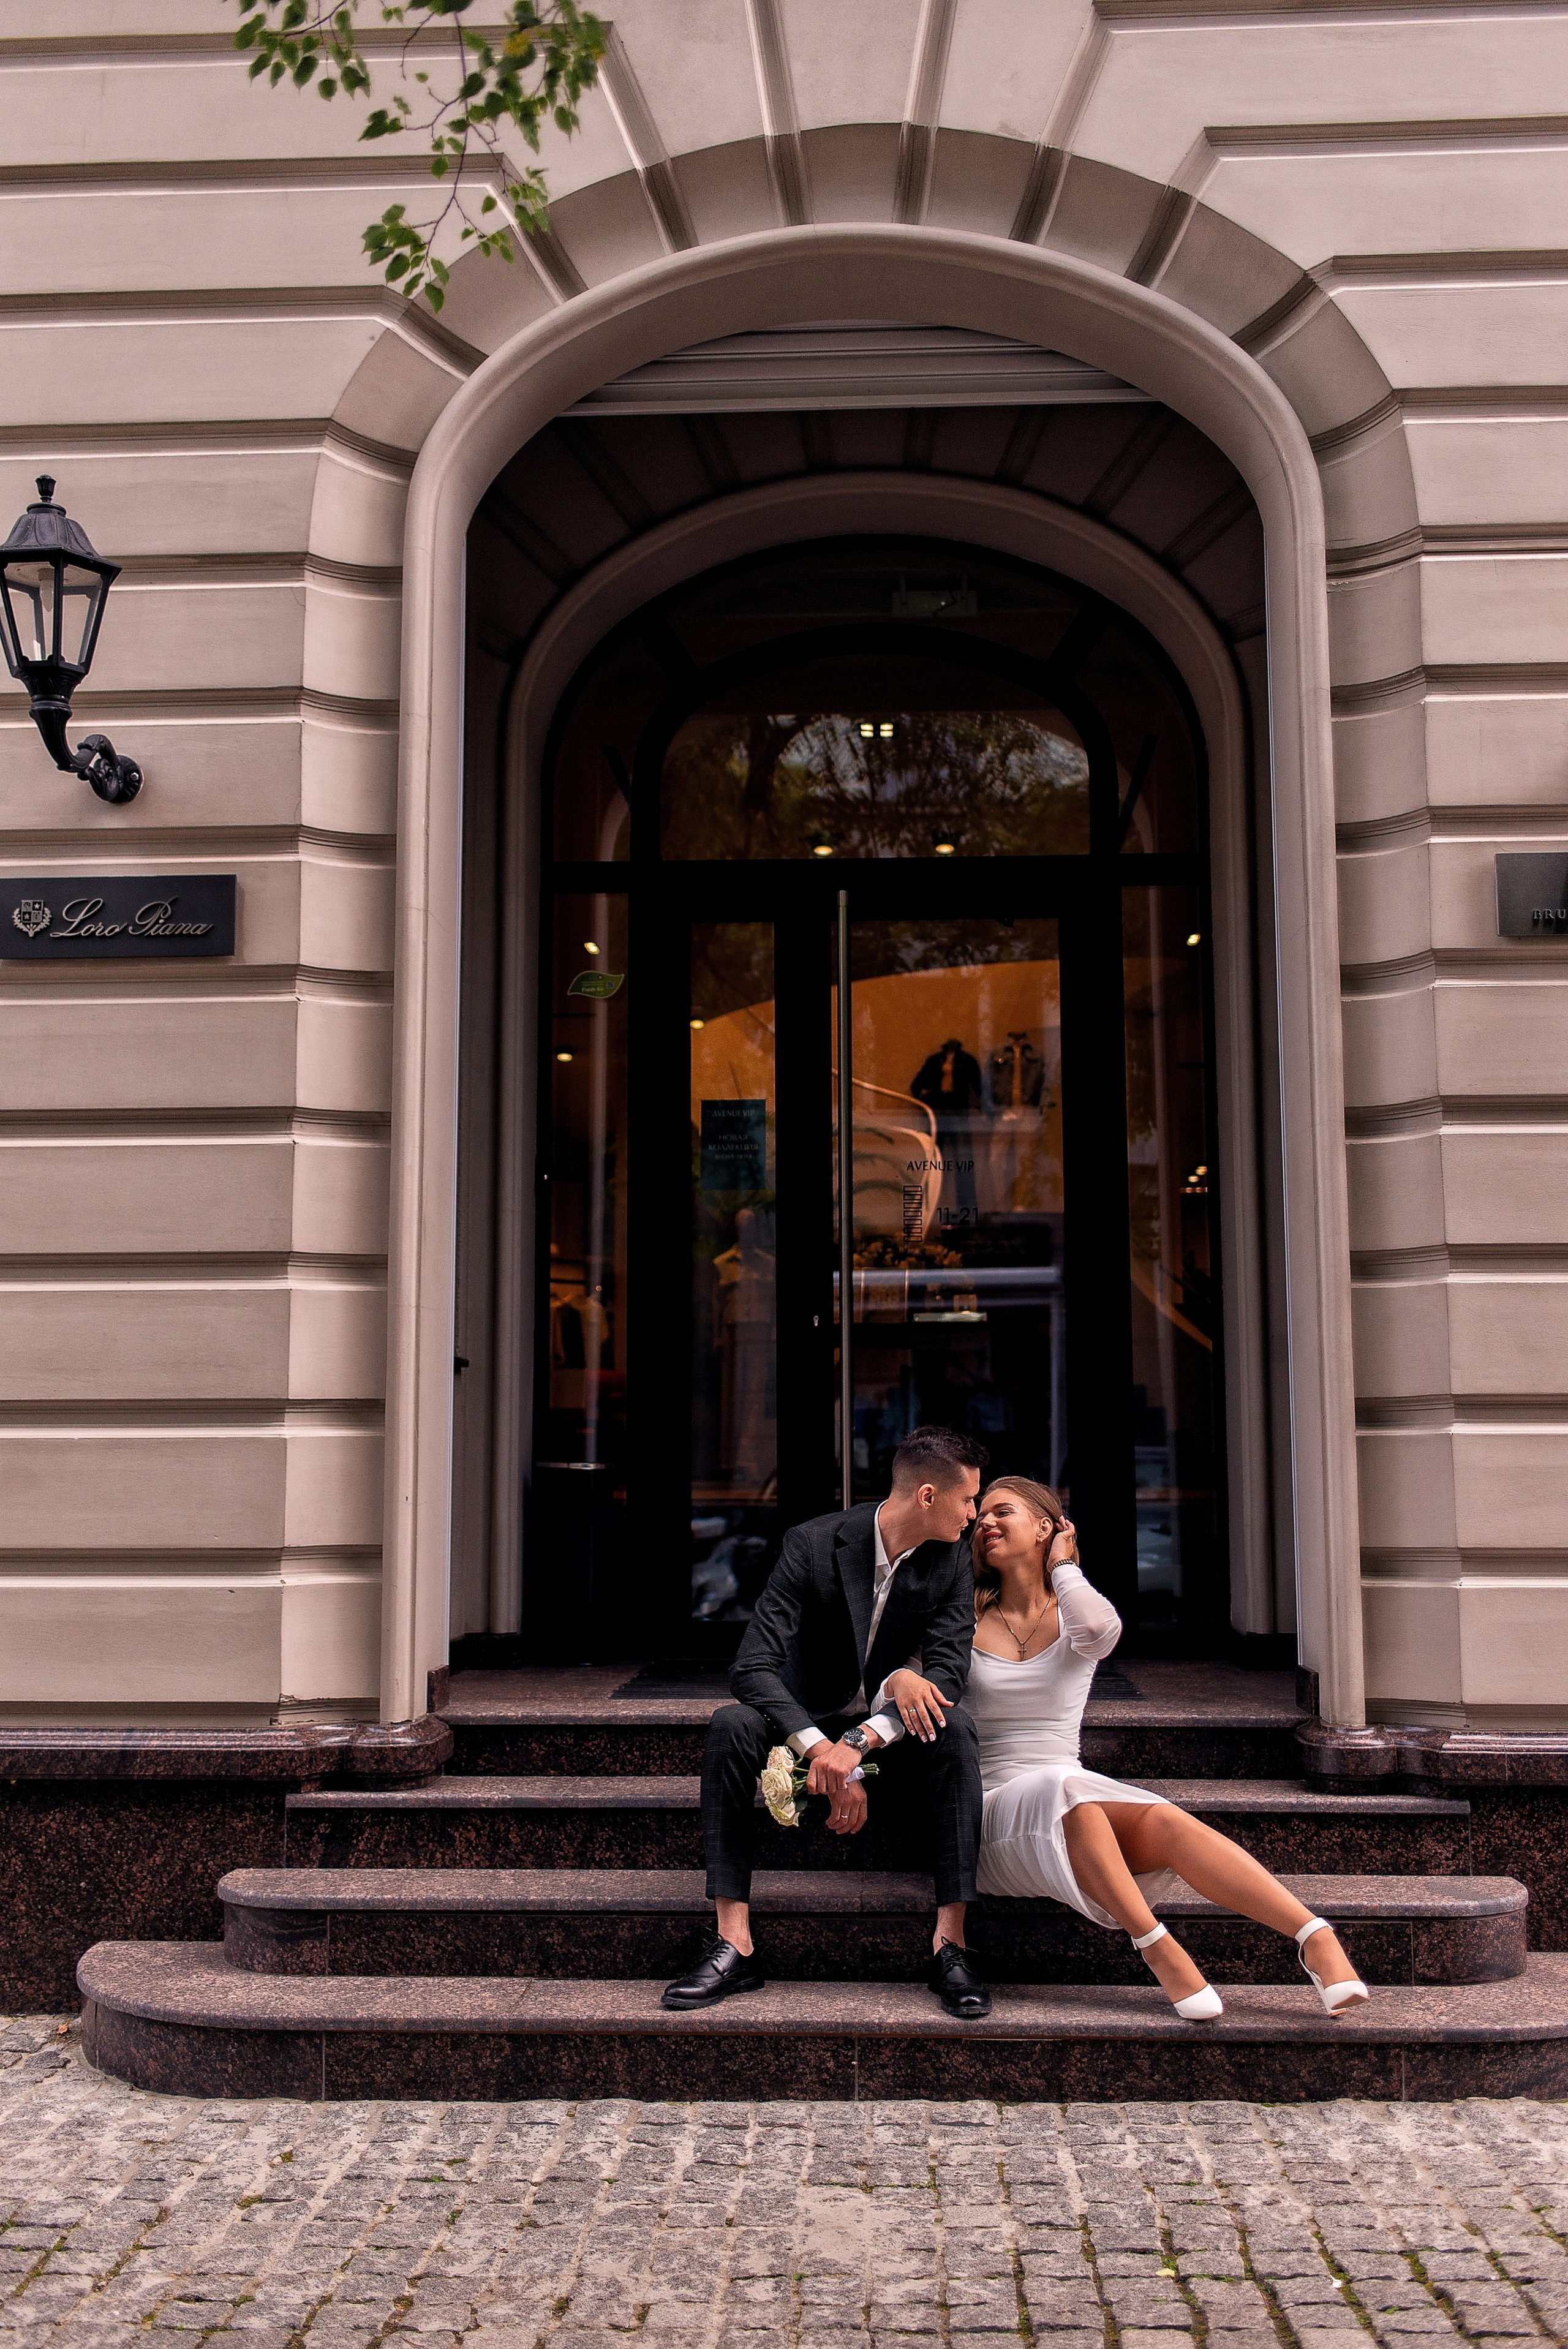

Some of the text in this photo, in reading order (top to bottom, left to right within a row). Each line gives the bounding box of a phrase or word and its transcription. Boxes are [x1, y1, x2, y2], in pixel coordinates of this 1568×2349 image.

[50, 895, 213, 938] Loro Piana
[1534, 909, 1566, 919] BRU
[907, 1160, 974, 1171] AVENUE VIP
[937, 1207, 979, 1224] 11-21
